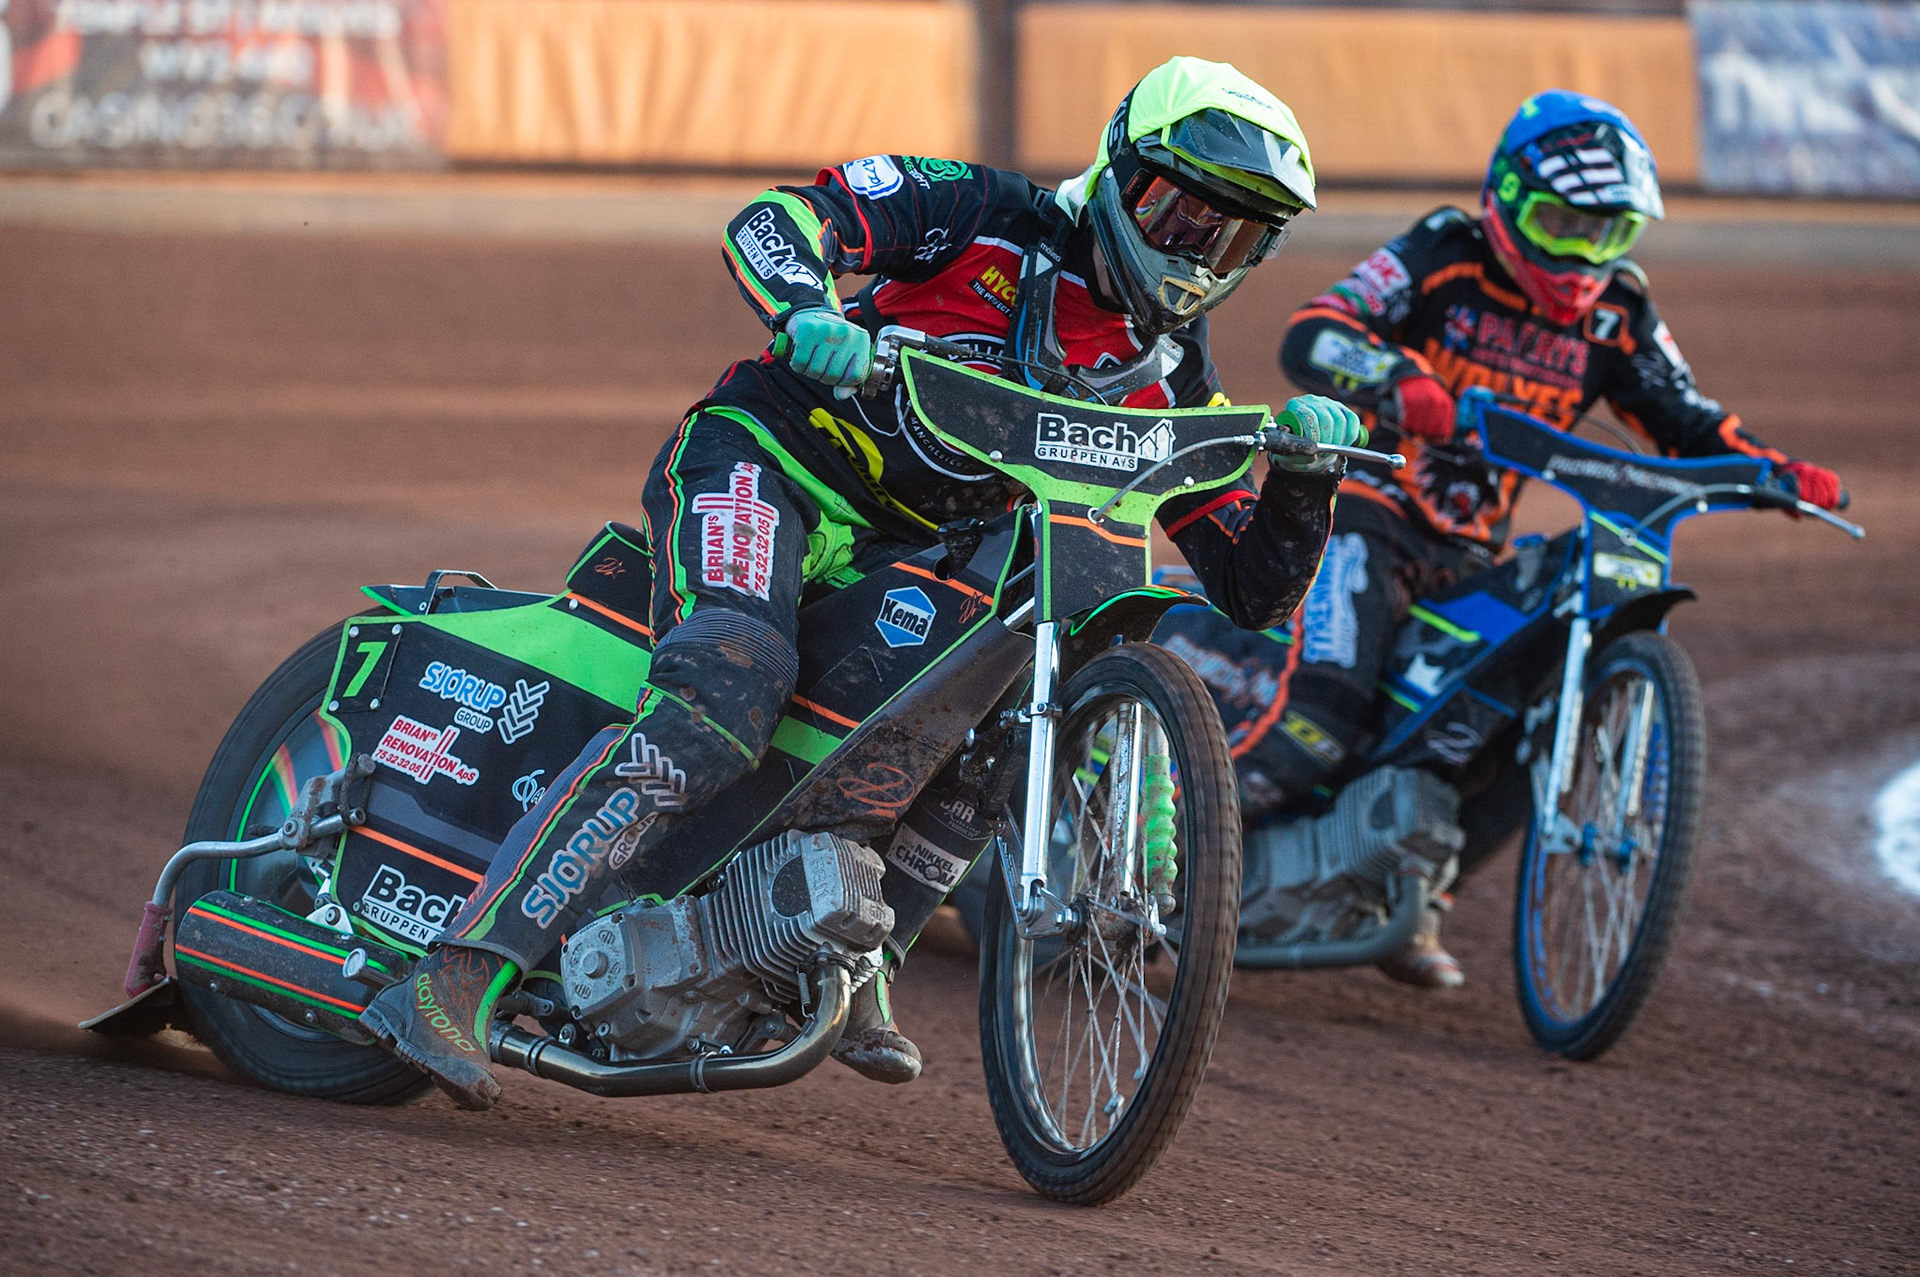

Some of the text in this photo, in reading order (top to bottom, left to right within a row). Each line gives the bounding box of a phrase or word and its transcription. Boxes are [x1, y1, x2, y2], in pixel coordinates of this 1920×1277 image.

[737, 229, 760, 260] GRUPPEN
[747, 208, 796, 269] Bach
[972, 281, 985, 297] THE
[1593, 308, 1620, 341] 7
[1039, 416, 1137, 454] Bach
[1037, 446, 1136, 469] GRUPPEN A/S
[707, 515, 726, 582] BRIAN'S
[757, 535, 769, 554] 32
[755, 553, 768, 574] 32
[879, 598, 930, 637] Kema
[342, 641, 388, 698] 7
[392, 719, 439, 742] BRIAN'S
[456, 710, 492, 731] GROUP
[374, 748, 422, 773] 75 32 32 05
[381, 734, 476, 781] RENOVATION ApS
[896, 844, 956, 887] CHROM
[914, 844, 954, 873] NIKKEL
[363, 903, 430, 941] GRUPPEN
[416, 973, 477, 1052] daytona
